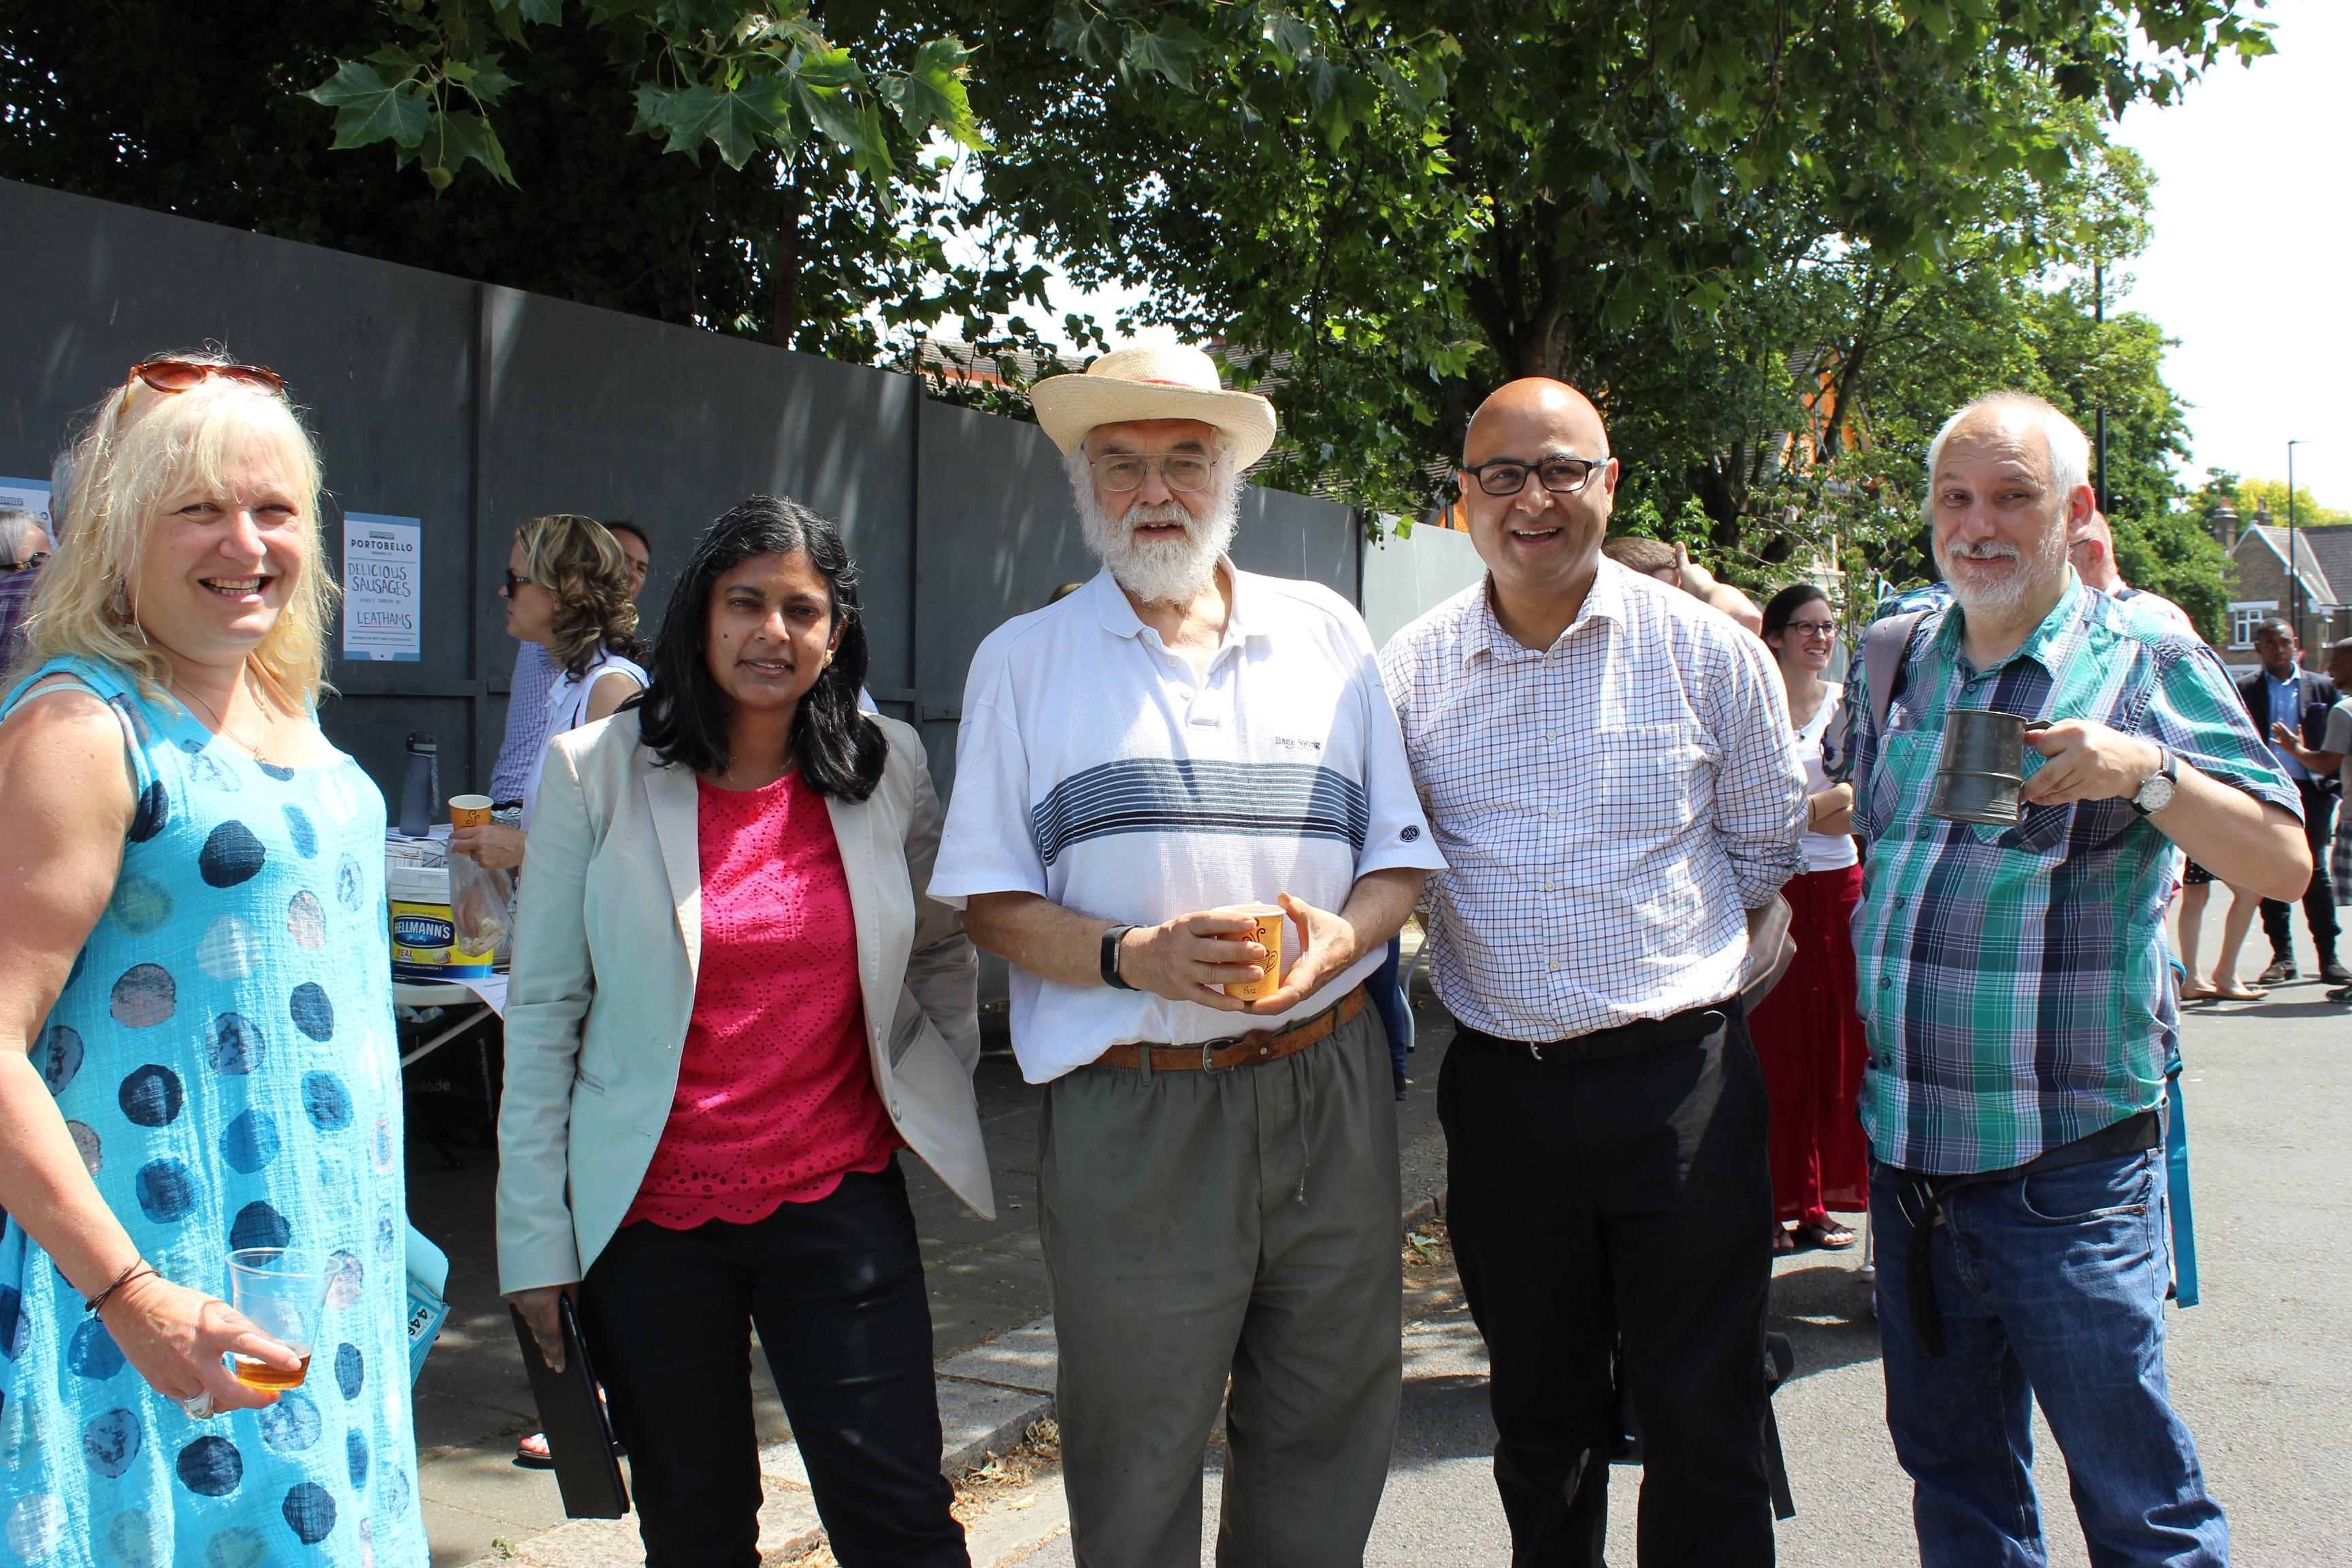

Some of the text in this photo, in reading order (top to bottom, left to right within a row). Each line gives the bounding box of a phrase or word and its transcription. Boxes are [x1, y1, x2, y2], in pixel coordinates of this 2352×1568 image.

[350, 539, 412, 552] PORTOBELLO
[348, 563, 406, 581] DELICIOUS
[351, 576, 411, 598] SAUSAGES
[357, 611, 412, 630] LEATHAMS
[395, 921, 451, 939] HELLMANN'S
[397, 949, 413, 958] REAL
[1243, 986, 1256, 994] 8oz
